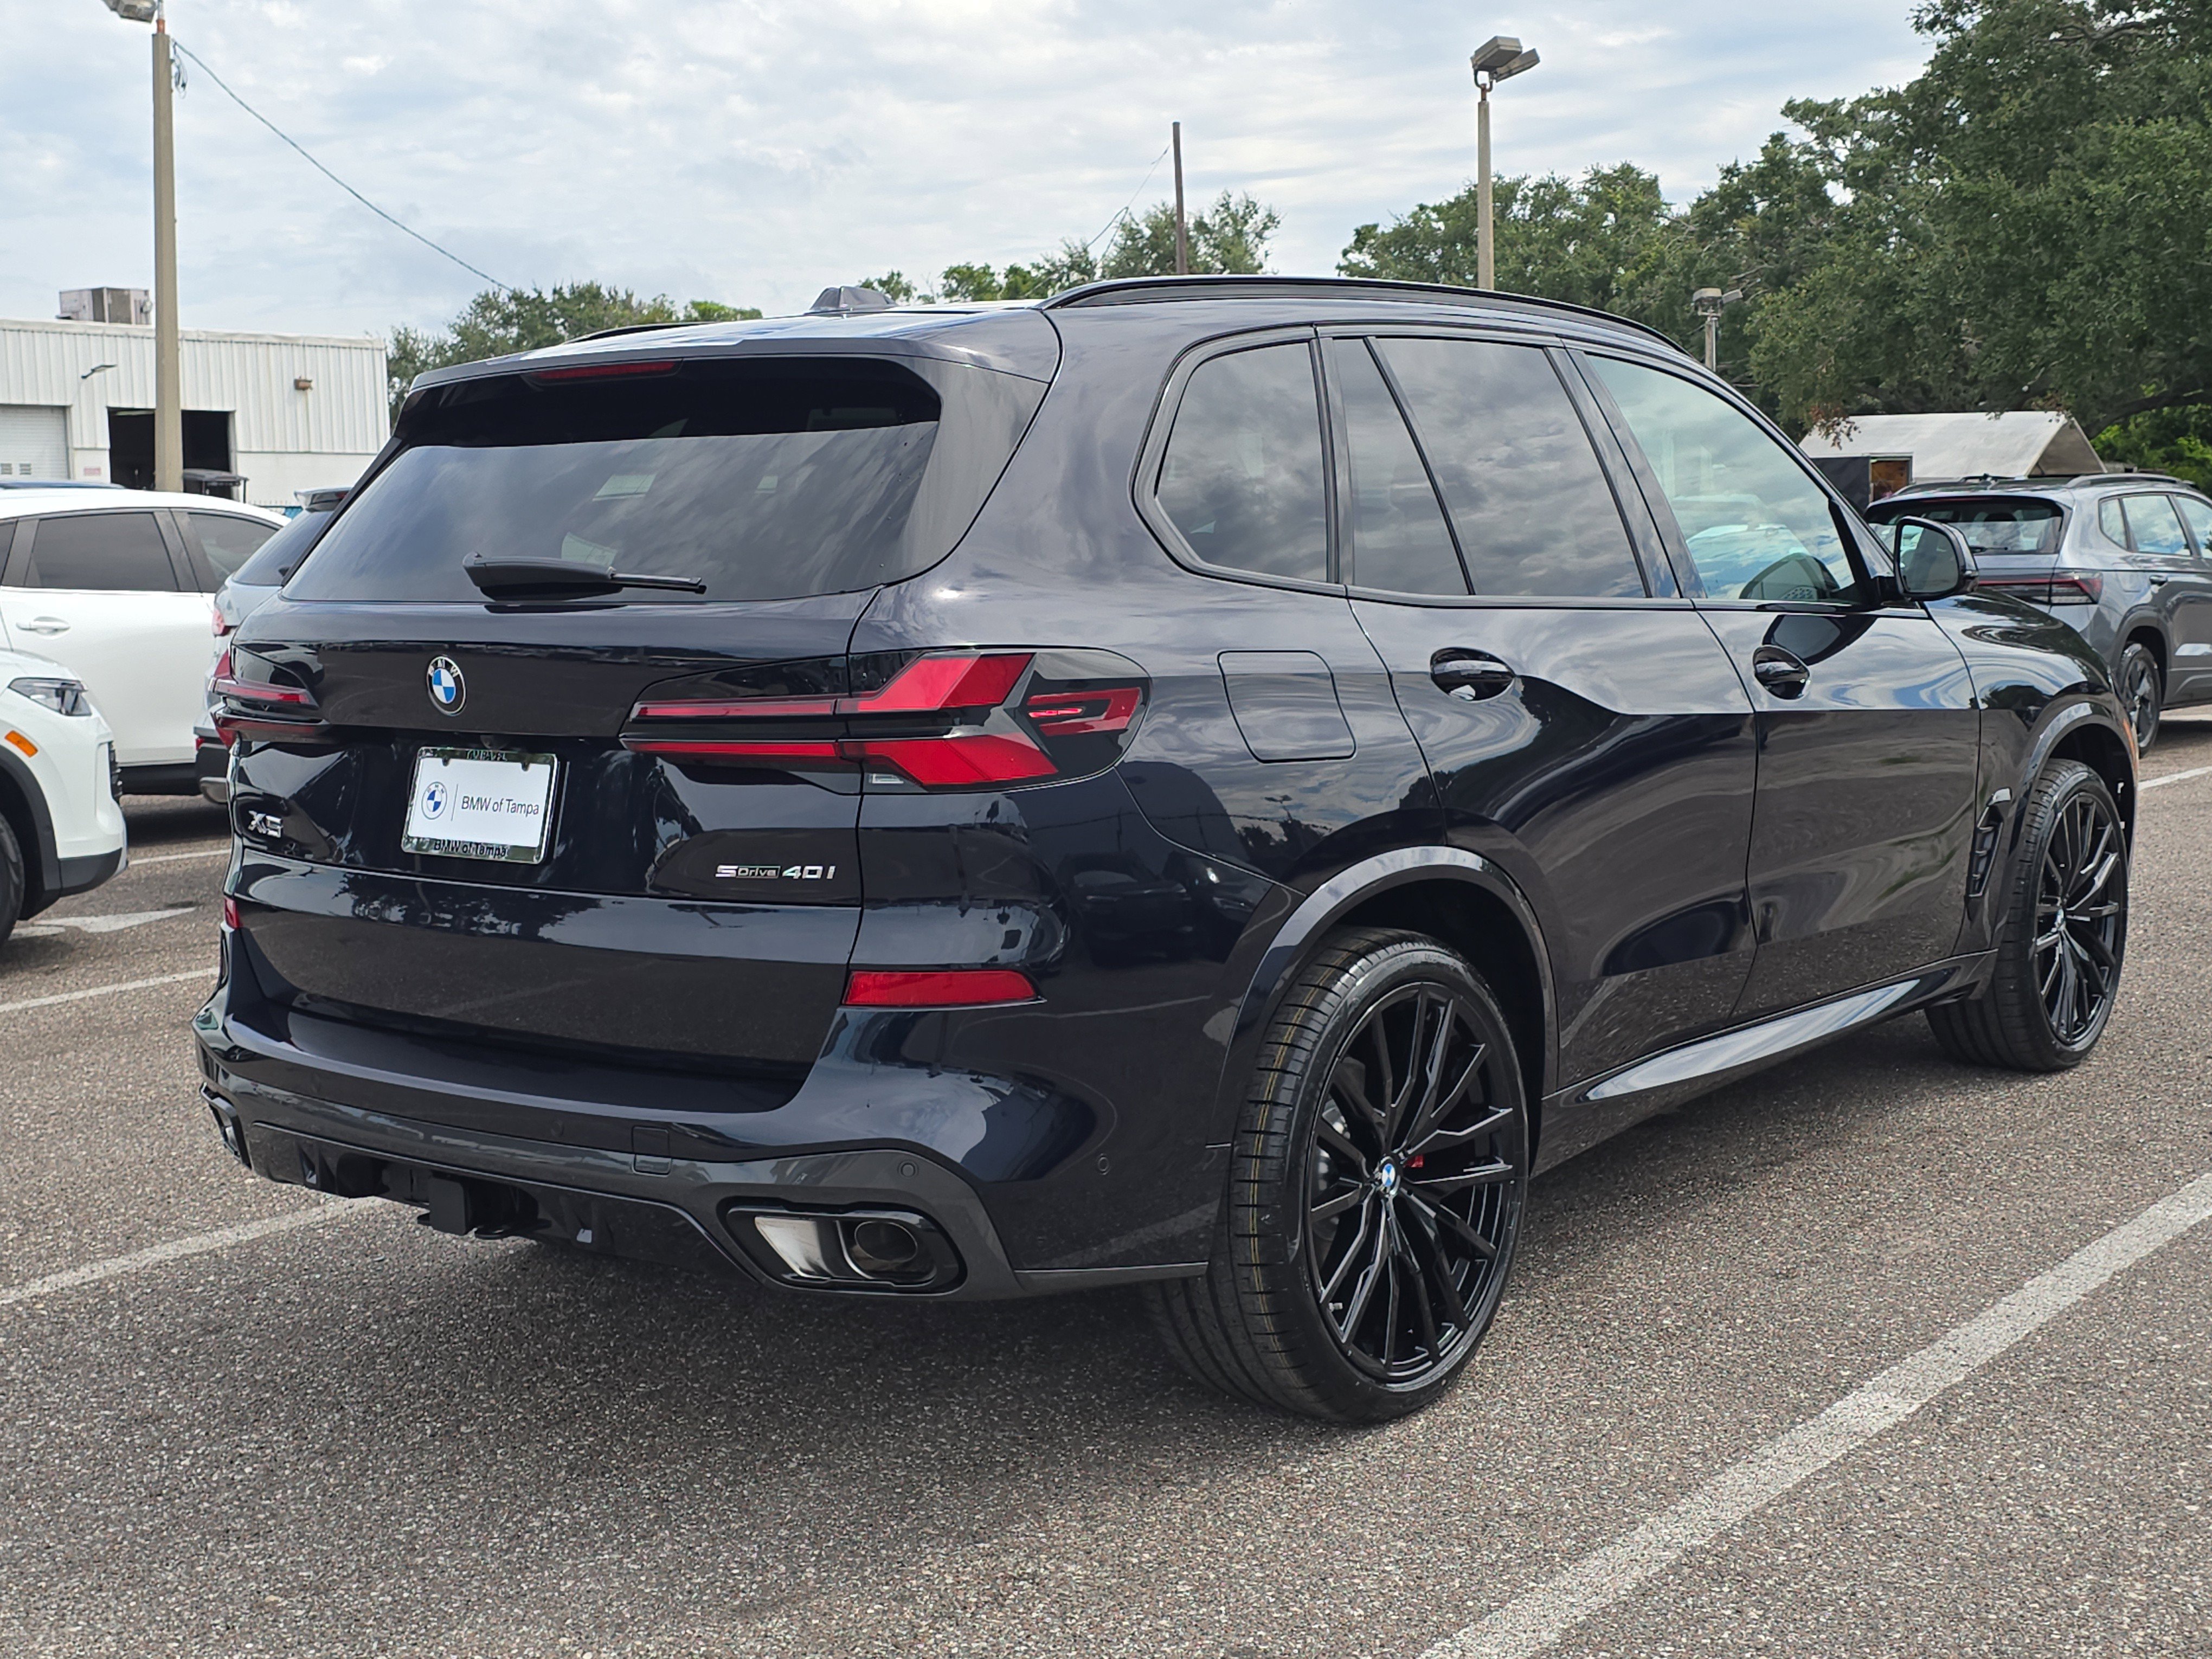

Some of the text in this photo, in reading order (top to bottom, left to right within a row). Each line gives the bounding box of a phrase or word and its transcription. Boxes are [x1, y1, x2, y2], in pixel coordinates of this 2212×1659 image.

[461, 796, 539, 818] BMW of Tampa
[248, 811, 283, 838] X5
[434, 839, 461, 853] BMW
[474, 843, 507, 859] Tampa
